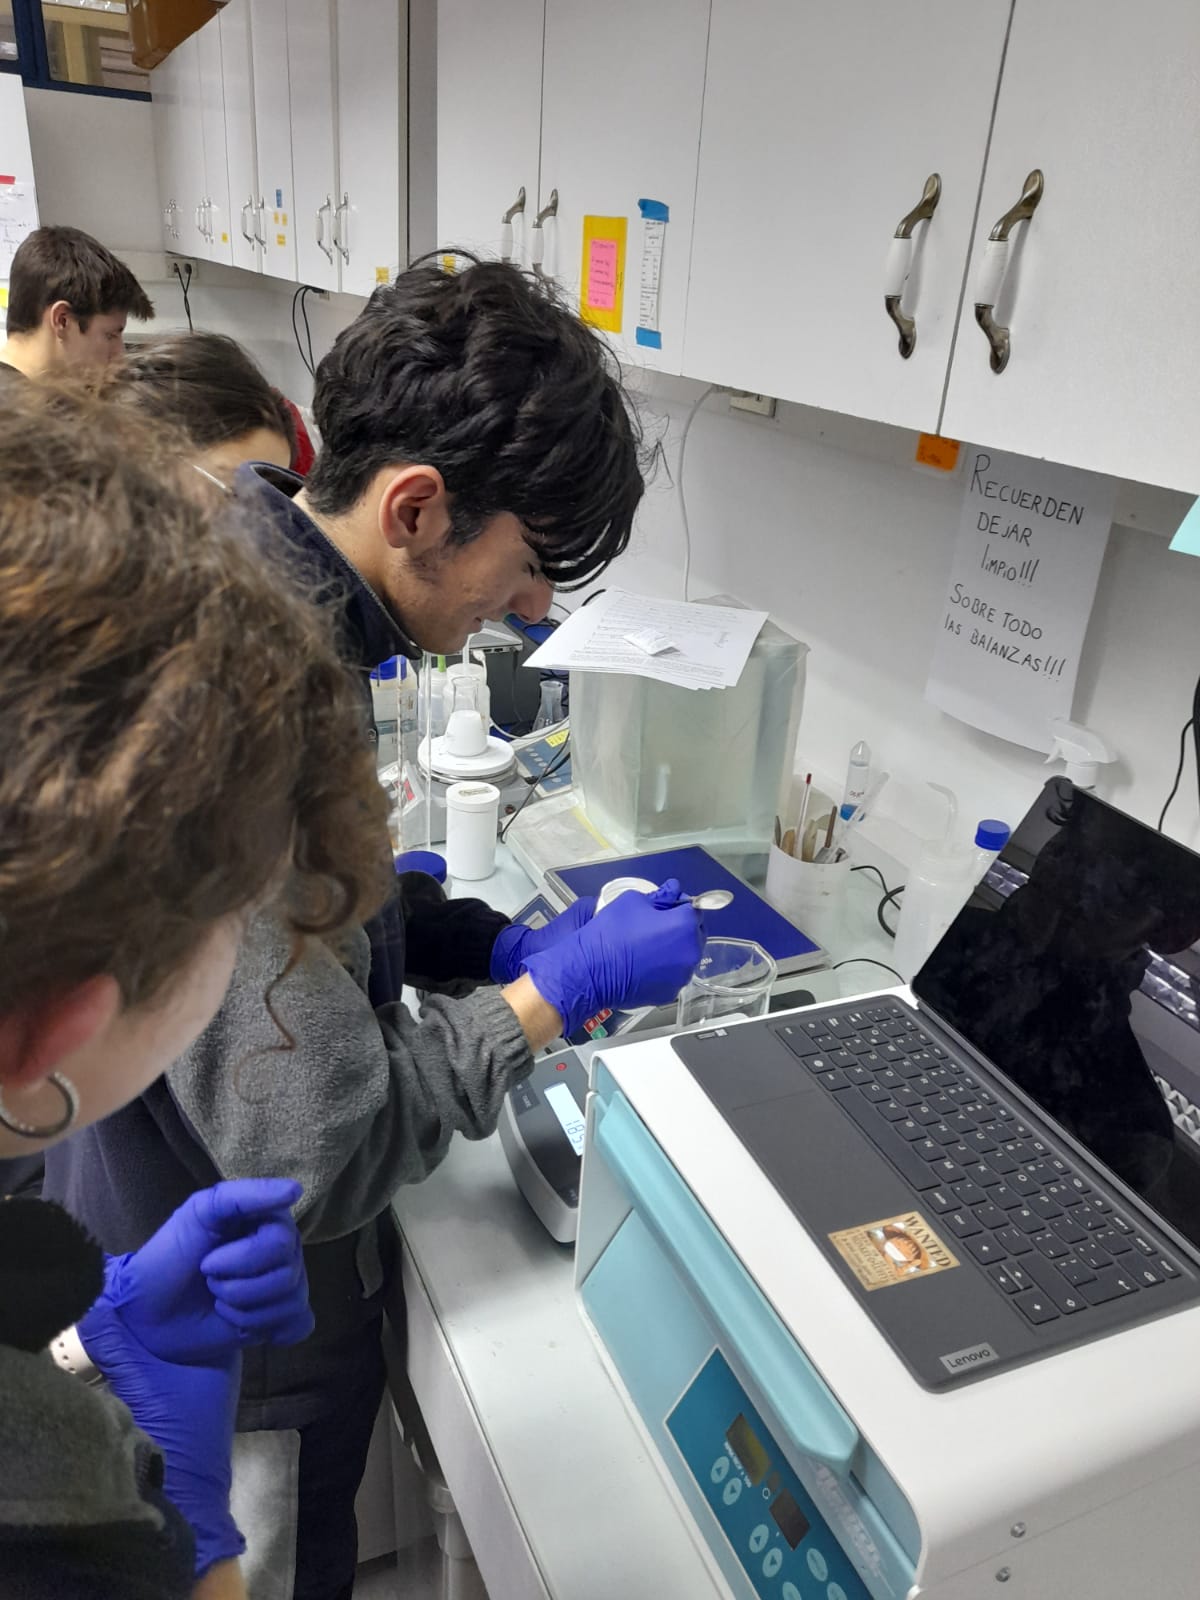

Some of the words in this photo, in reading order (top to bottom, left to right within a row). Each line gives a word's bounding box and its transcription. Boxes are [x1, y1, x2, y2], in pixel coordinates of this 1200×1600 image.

[970, 454, 1084, 525] RECUERDEN
[950, 583, 997, 623] SOBRE
[1002, 612, 1043, 640] TODO
[904, 1215, 951, 1267] WANTED
[947, 1349, 991, 1369] Lenovo
